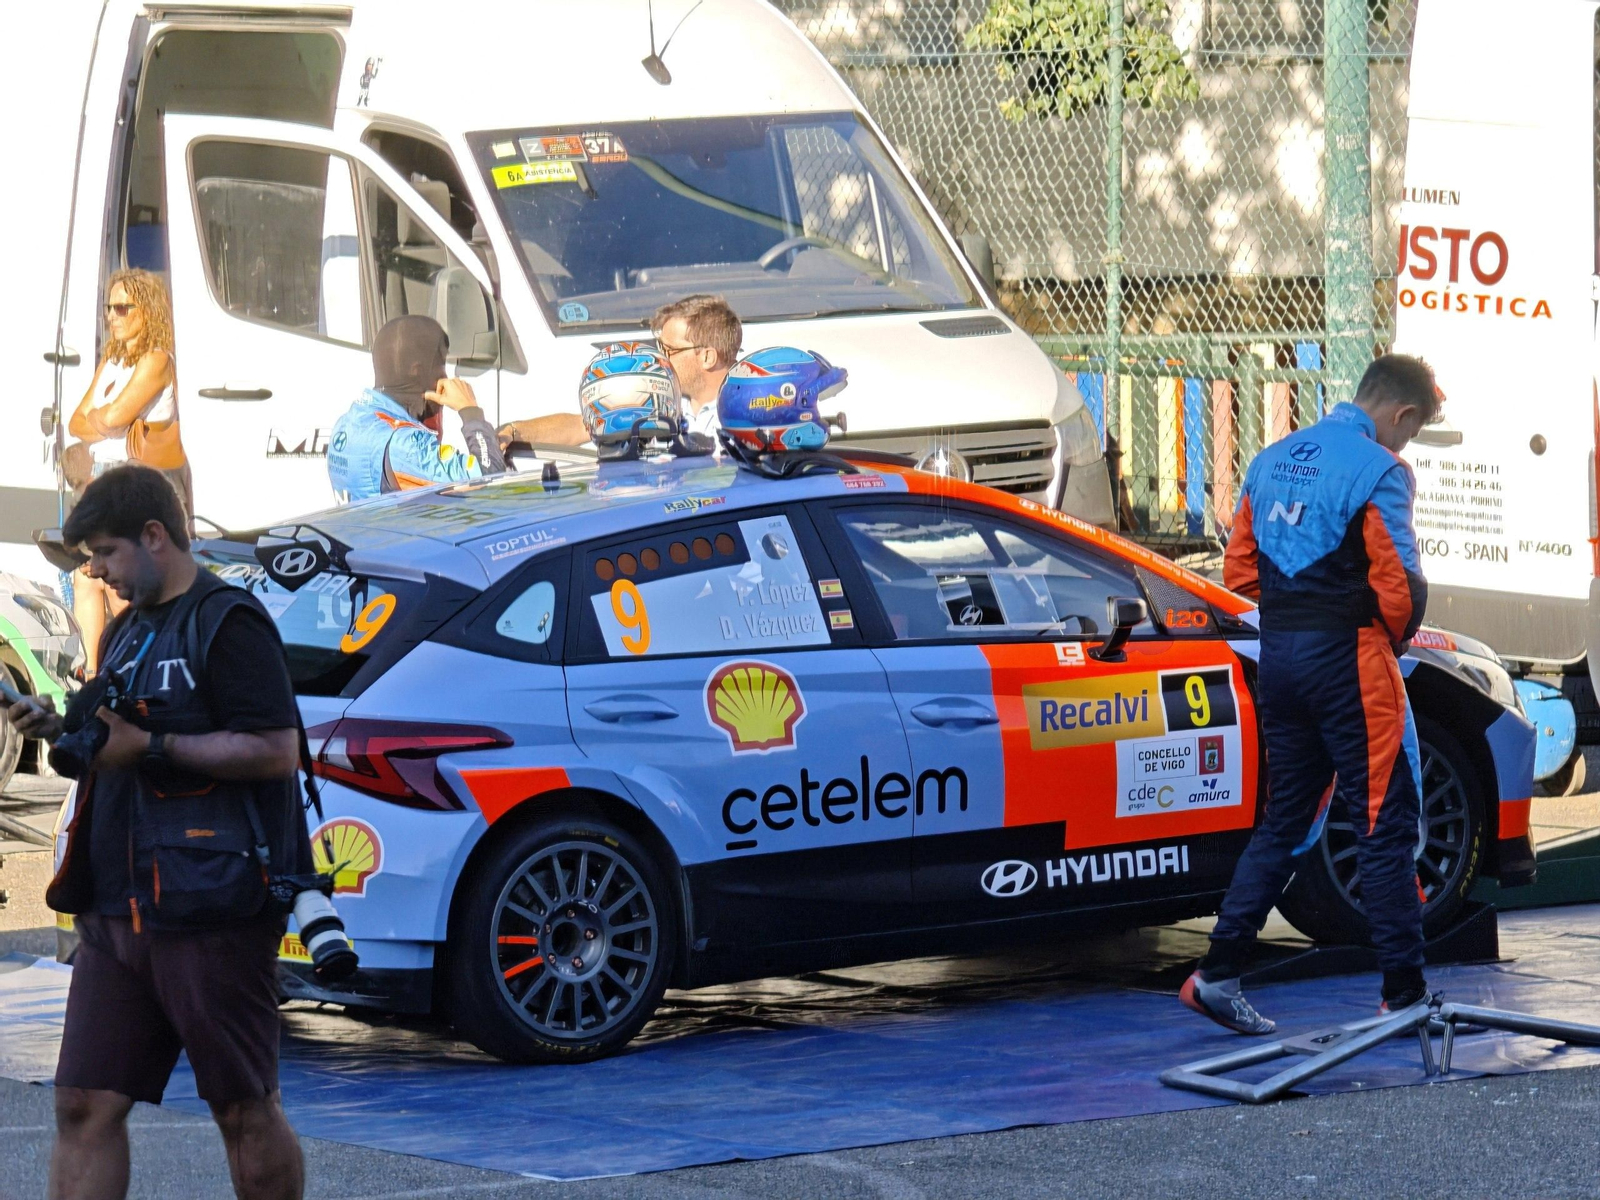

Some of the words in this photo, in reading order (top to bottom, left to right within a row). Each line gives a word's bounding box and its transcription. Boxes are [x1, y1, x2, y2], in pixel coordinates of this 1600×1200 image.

[1041, 503, 1097, 535] HYUNDAI
[484, 530, 554, 555] TOPTUL
[1464, 542, 1509, 563] SPAIN
[341, 593, 397, 653] 9
[610, 579, 651, 655] 9
[743, 611, 821, 640] Vázquez
[1040, 690, 1149, 732] Recalvi
[1184, 675, 1211, 726] 9
[1138, 746, 1191, 761] CONCELLO
[1144, 762, 1158, 773] DE
[1161, 759, 1186, 771] VIGO
[721, 755, 968, 836] cetelem
[1188, 789, 1231, 804] amura
[1045, 845, 1190, 888] HYUNDAI
